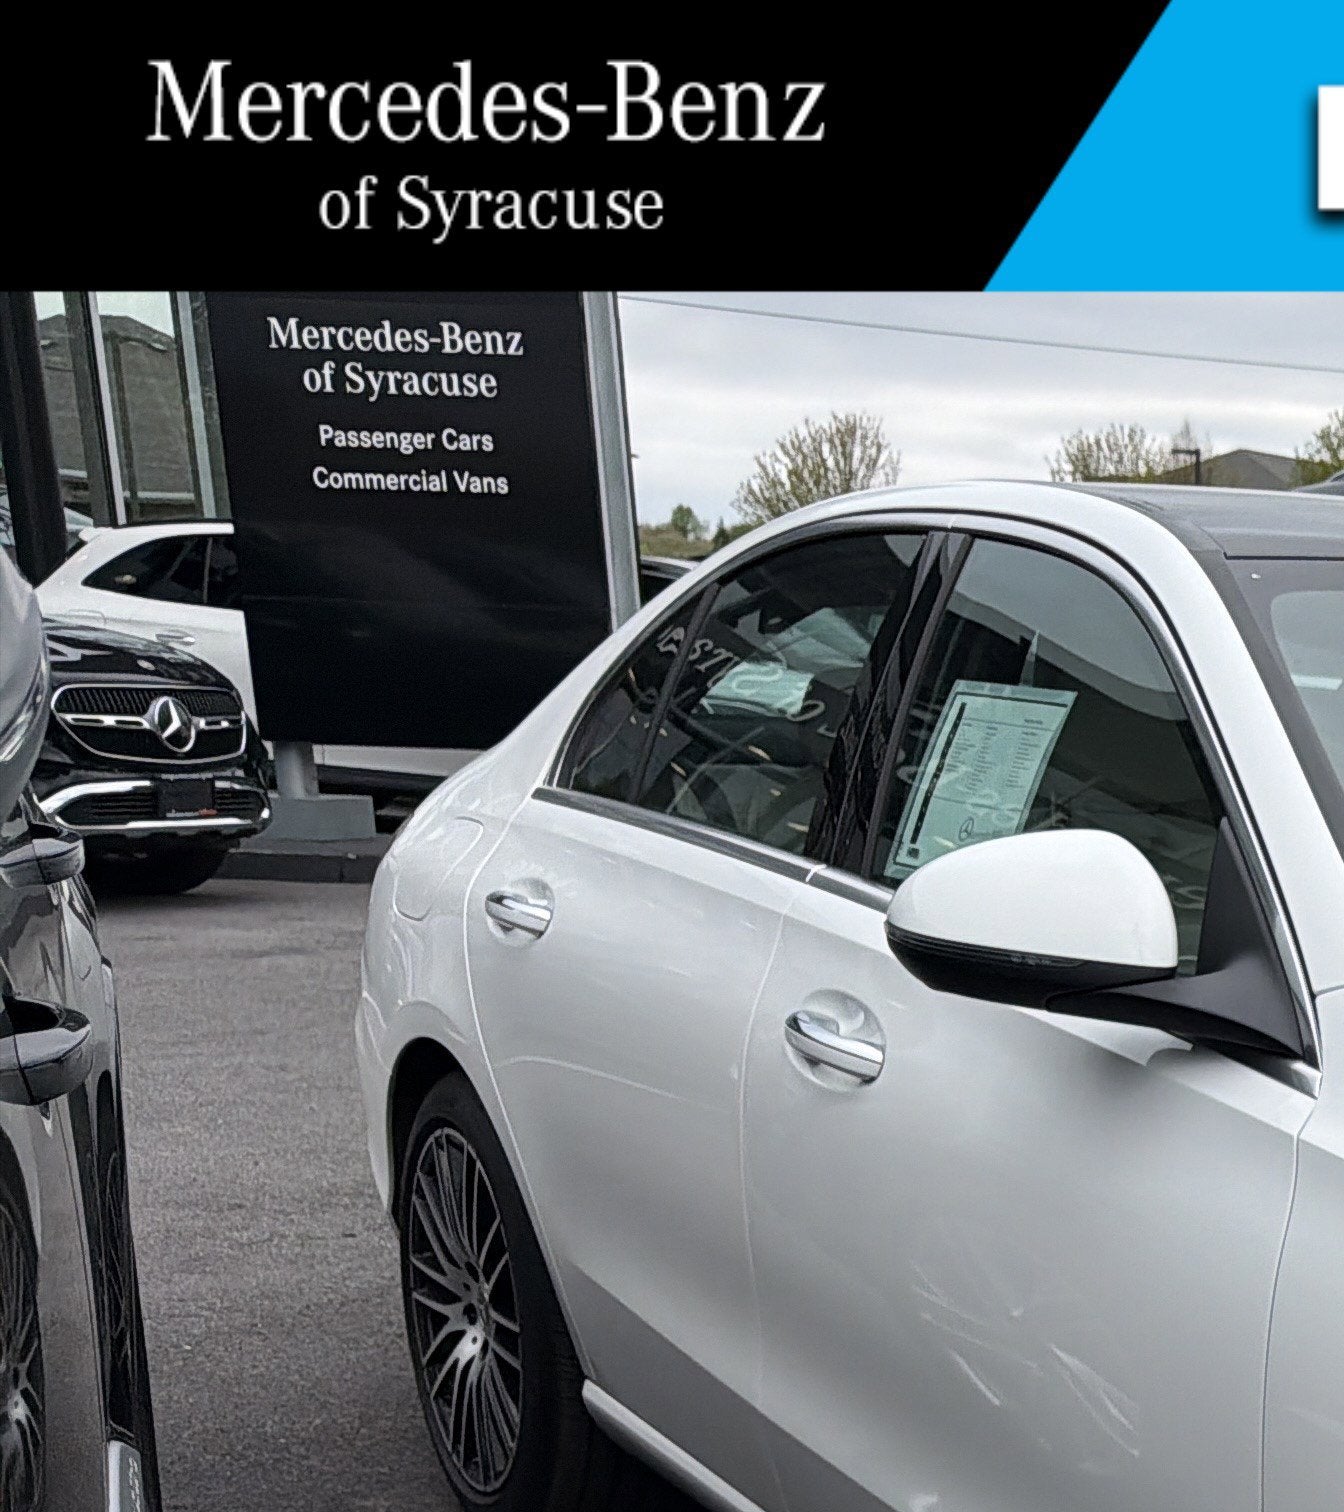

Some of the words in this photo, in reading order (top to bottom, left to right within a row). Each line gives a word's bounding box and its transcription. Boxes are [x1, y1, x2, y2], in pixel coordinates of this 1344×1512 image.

[267, 316, 524, 356] Mercedes-Benz
[303, 360, 335, 393] of
[345, 361, 498, 402] Syracuse
[318, 424, 436, 455] Passenger
[442, 427, 494, 452] Cars
[312, 466, 447, 493] Commercial
[453, 470, 509, 495] Vans
